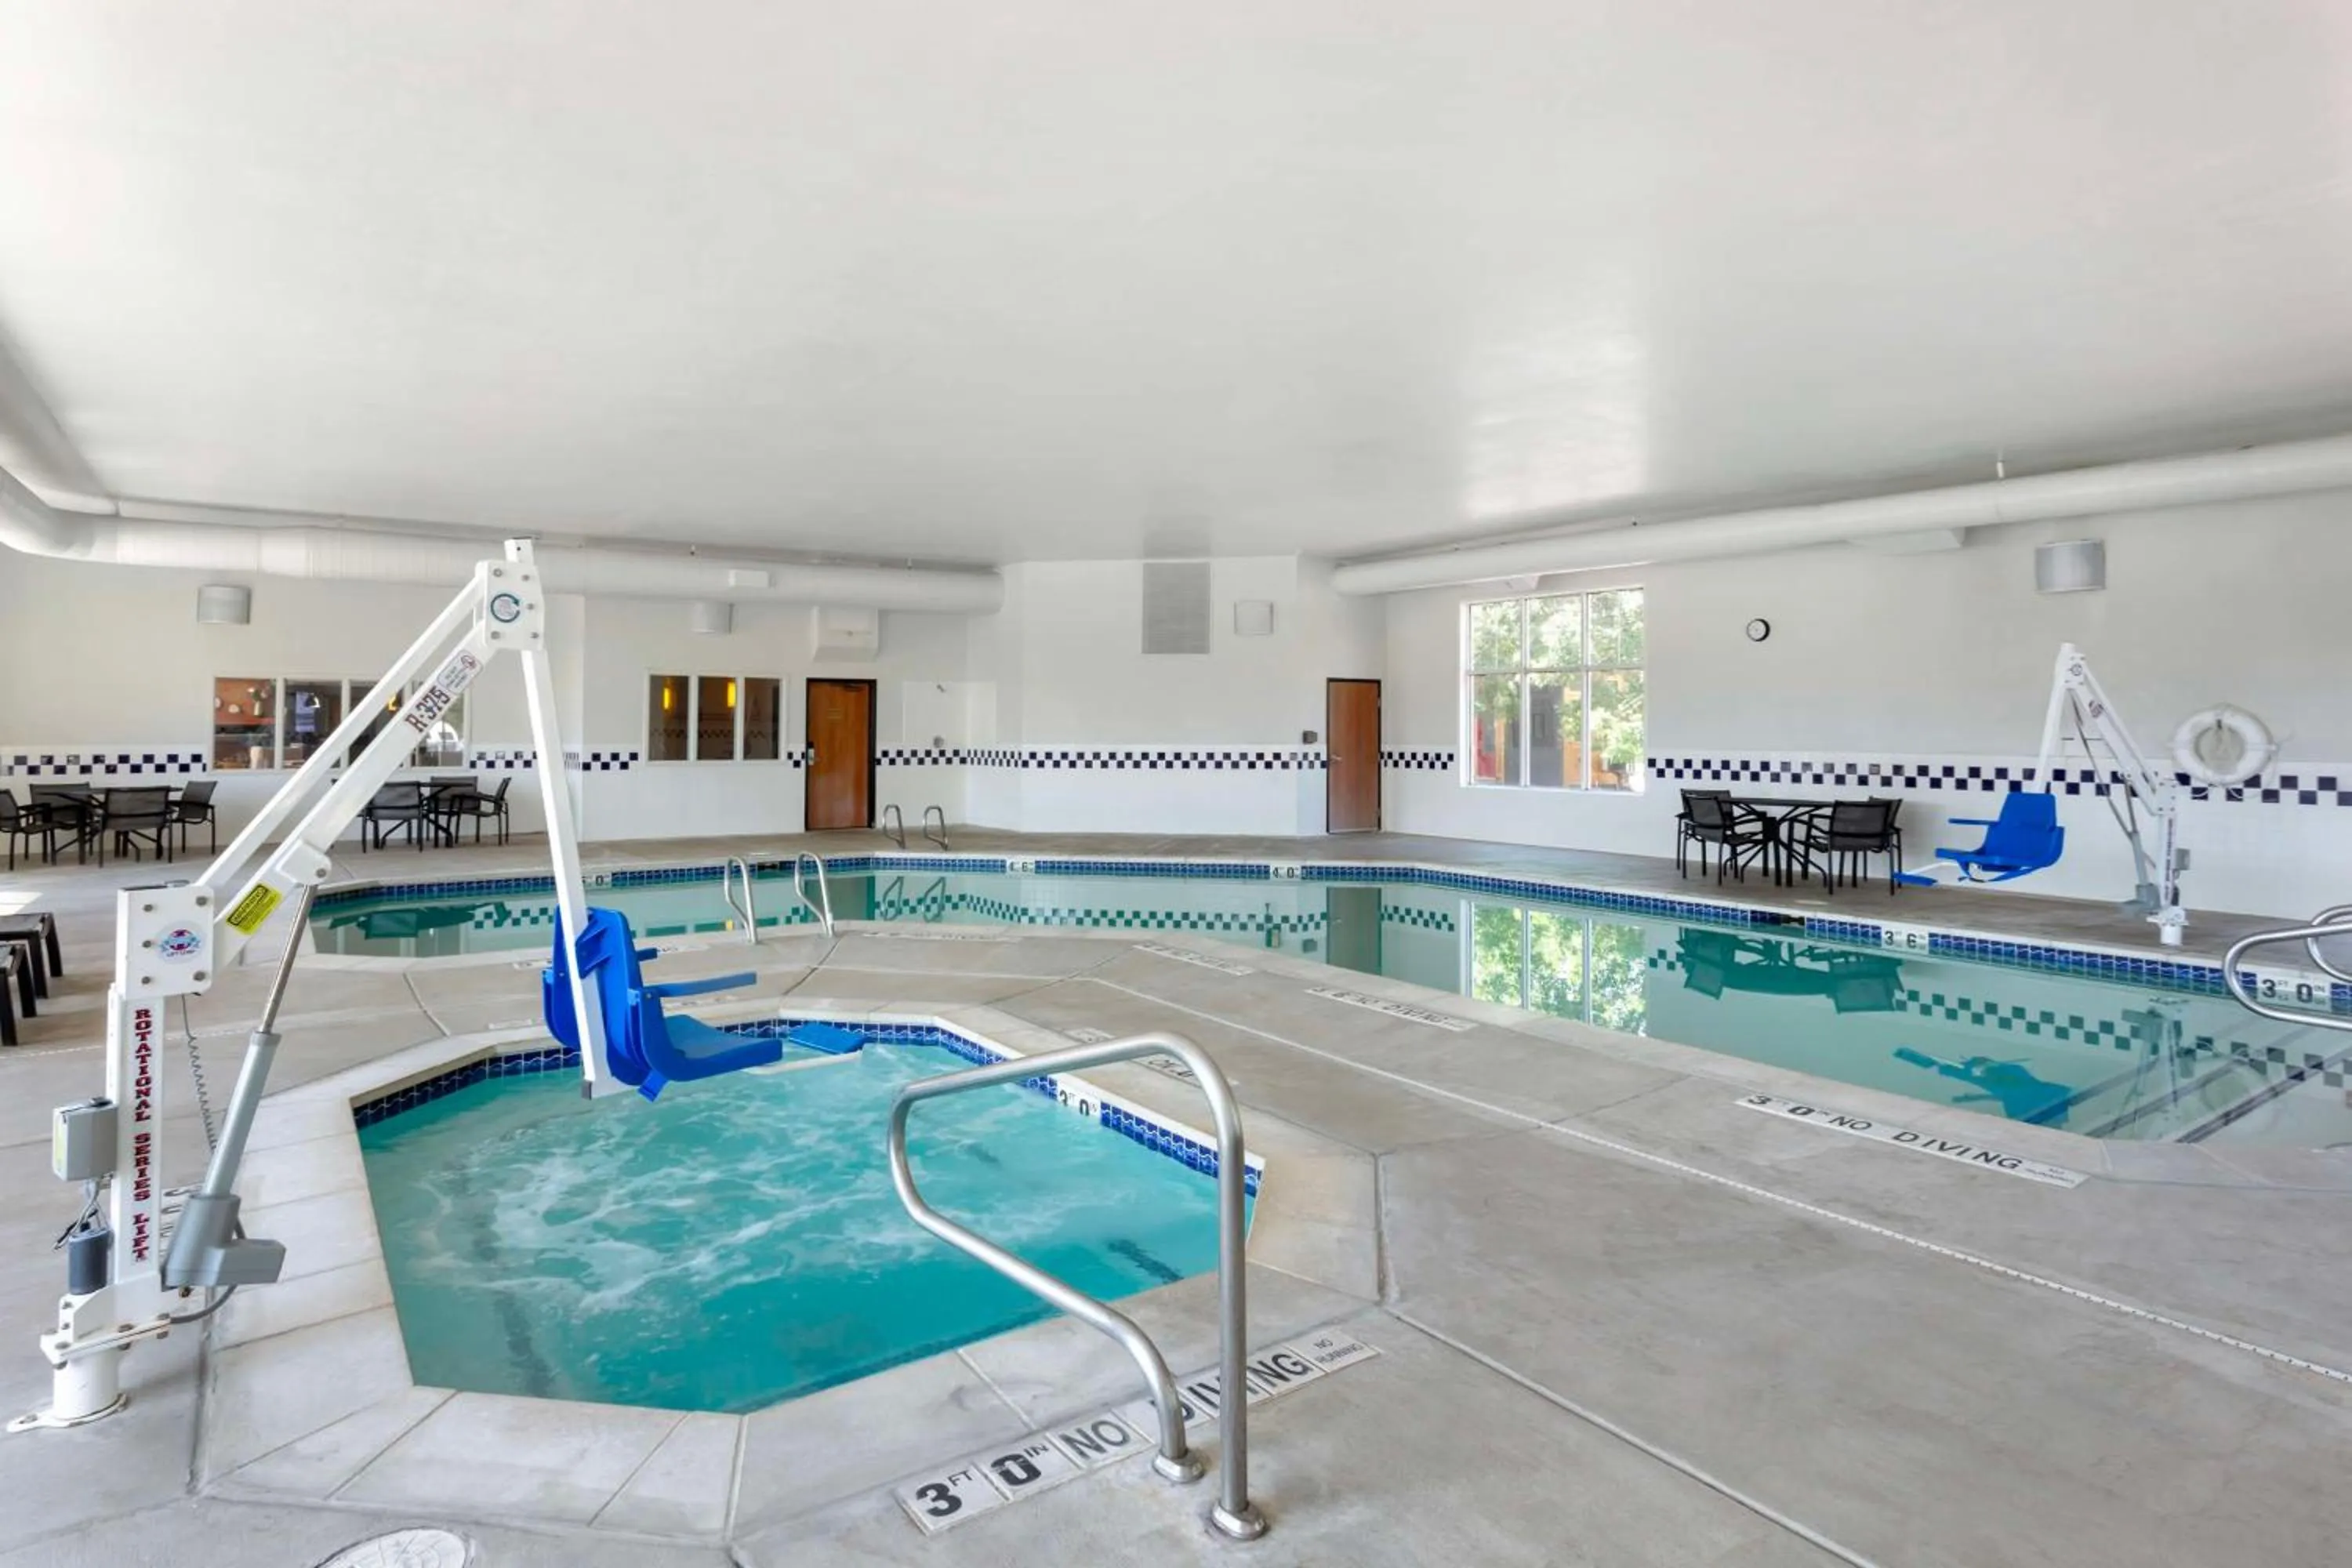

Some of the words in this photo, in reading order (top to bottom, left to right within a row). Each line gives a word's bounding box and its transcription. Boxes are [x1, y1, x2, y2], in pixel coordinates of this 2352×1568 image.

[1884, 931, 1894, 946] 3
[1906, 932, 1917, 949] 6
[2262, 978, 2276, 998] 3
[2296, 982, 2313, 1003] 0
[135, 1008, 153, 1122] ROTATIONAL
[134, 1133, 151, 1201] SERIES
[1828, 1116, 1873, 1131] NO
[1891, 1131, 2023, 1170] DIVING
[132, 1213, 150, 1261] LIFT
[915, 1482, 963, 1517] 3
[948, 1468, 974, 1487] FT
[989, 1453, 1042, 1486] 0
[1022, 1443, 1050, 1458] IN
[1058, 1420, 1131, 1461] NO
[1149, 1352, 1315, 1421] ING
